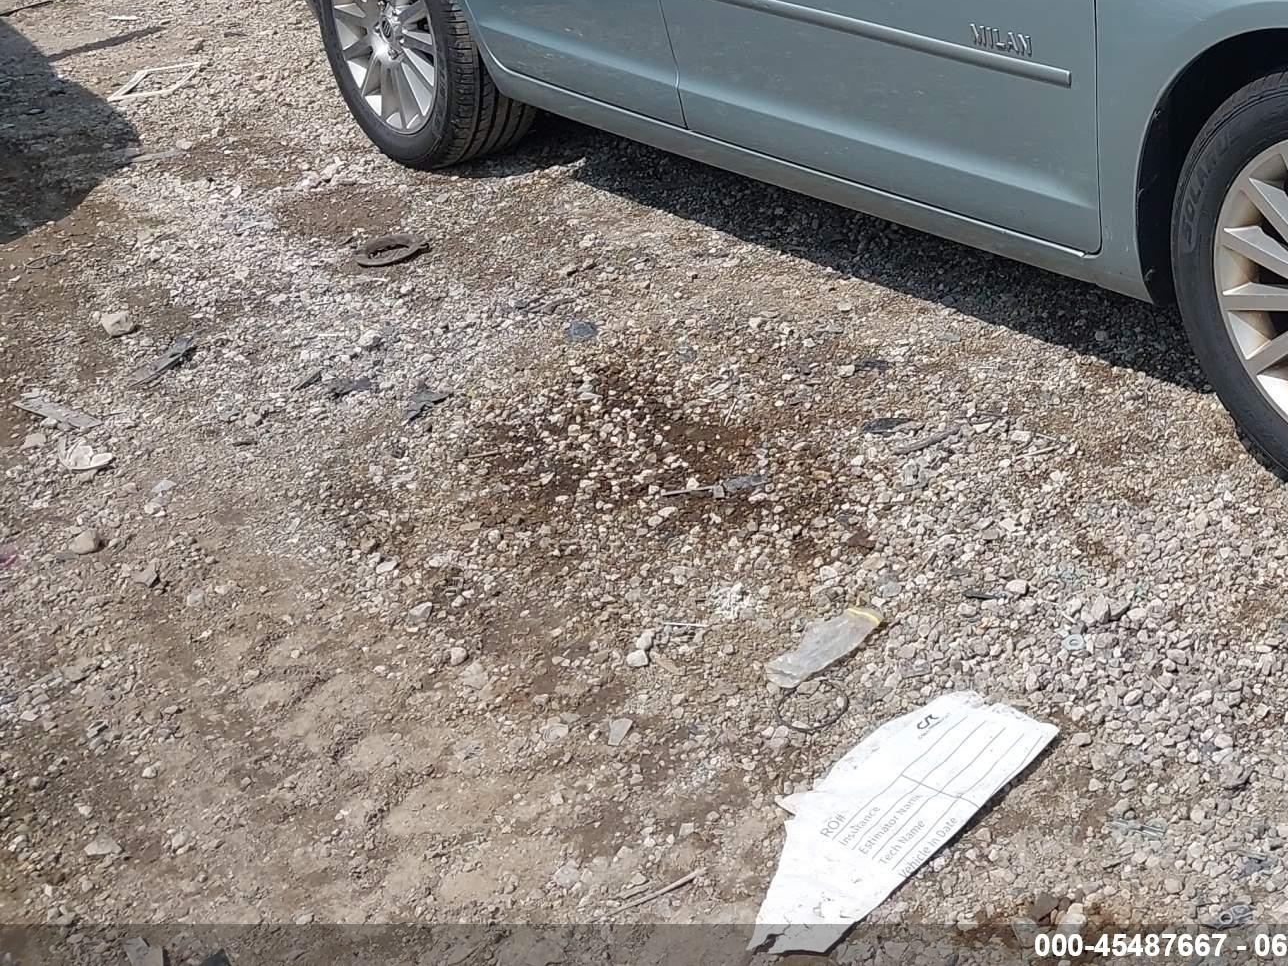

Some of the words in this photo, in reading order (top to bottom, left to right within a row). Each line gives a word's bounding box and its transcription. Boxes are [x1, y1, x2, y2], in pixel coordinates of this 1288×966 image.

[970, 23, 1032, 57] MILAN
[858, 815, 900, 855] Estimator
[878, 840, 903, 866] Tech
[899, 819, 926, 844] Name
[898, 848, 932, 880] Vehicle
[928, 835, 941, 851] In
[936, 816, 959, 838] Date
